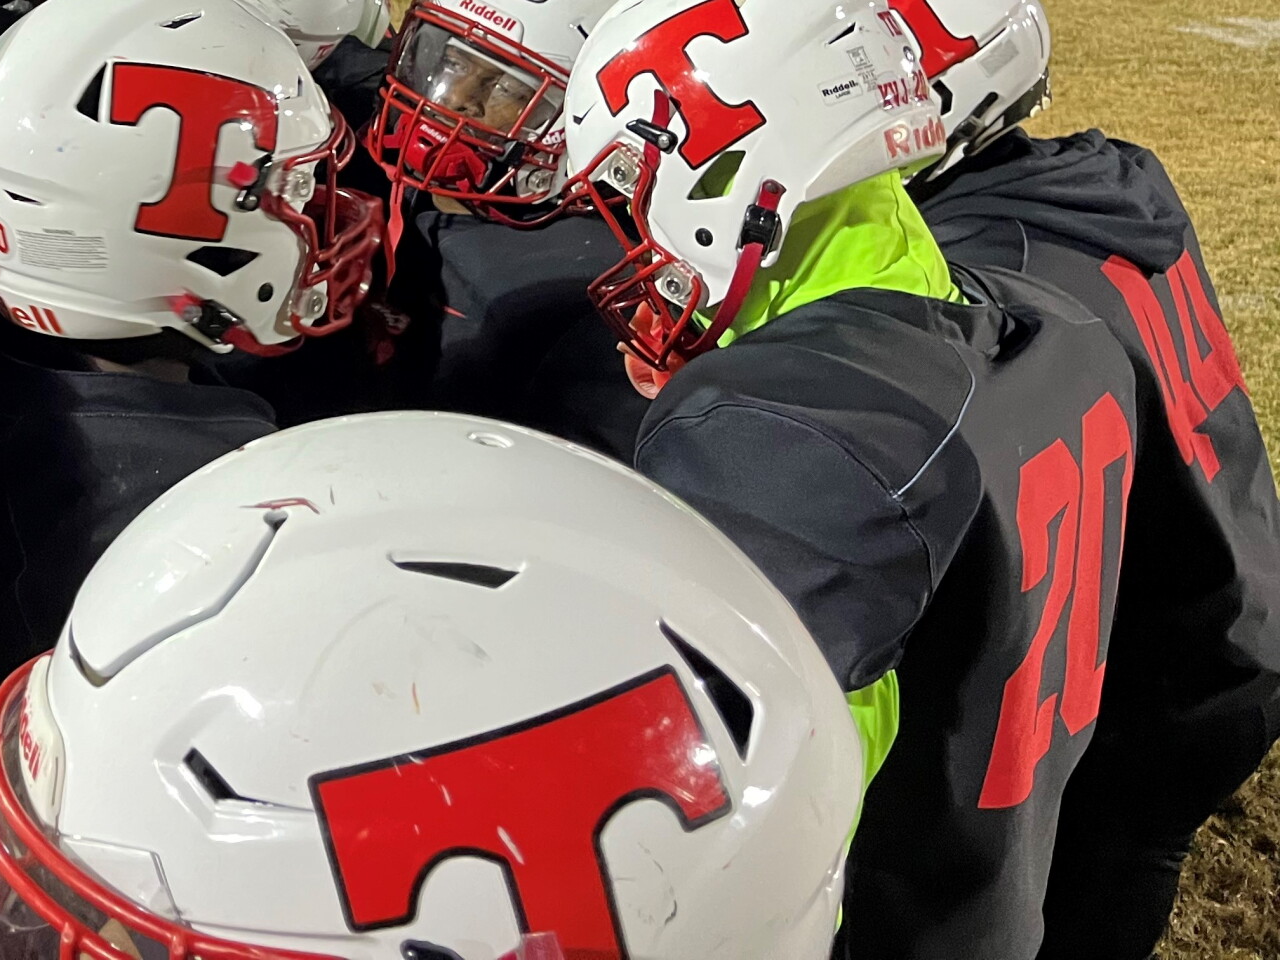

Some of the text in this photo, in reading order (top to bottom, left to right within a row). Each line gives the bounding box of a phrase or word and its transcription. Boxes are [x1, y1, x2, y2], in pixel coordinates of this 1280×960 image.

[109, 61, 280, 242] T
[821, 80, 858, 97] Riddell
[884, 115, 946, 158] Ridd
[978, 392, 1134, 809] 20
[308, 663, 733, 960] T
